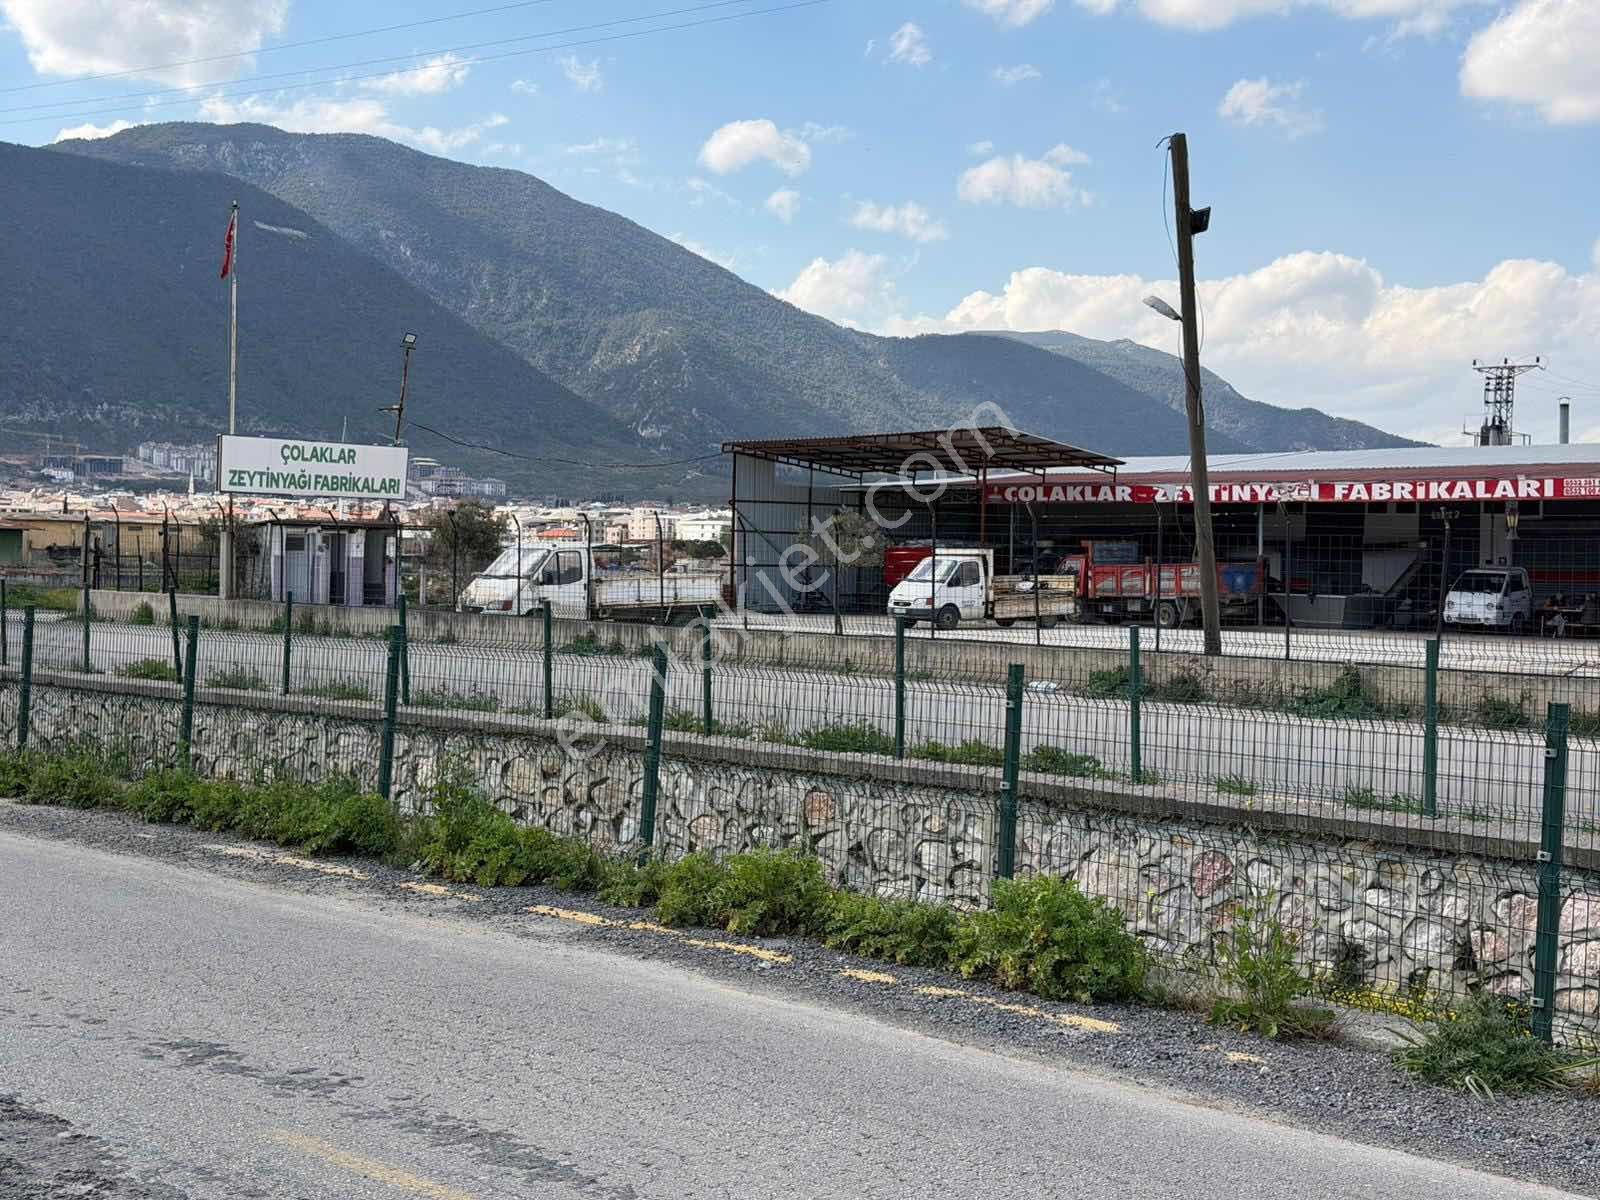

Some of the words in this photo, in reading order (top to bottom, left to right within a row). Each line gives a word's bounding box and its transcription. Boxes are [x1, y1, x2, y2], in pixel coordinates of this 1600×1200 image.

[280, 444, 357, 465] ÇOLAKLAR
[228, 467, 311, 490] ZEYTİNYAĞI
[314, 472, 400, 494] FABRİKALARI
[1334, 479, 1554, 500] FABRİKALARI
